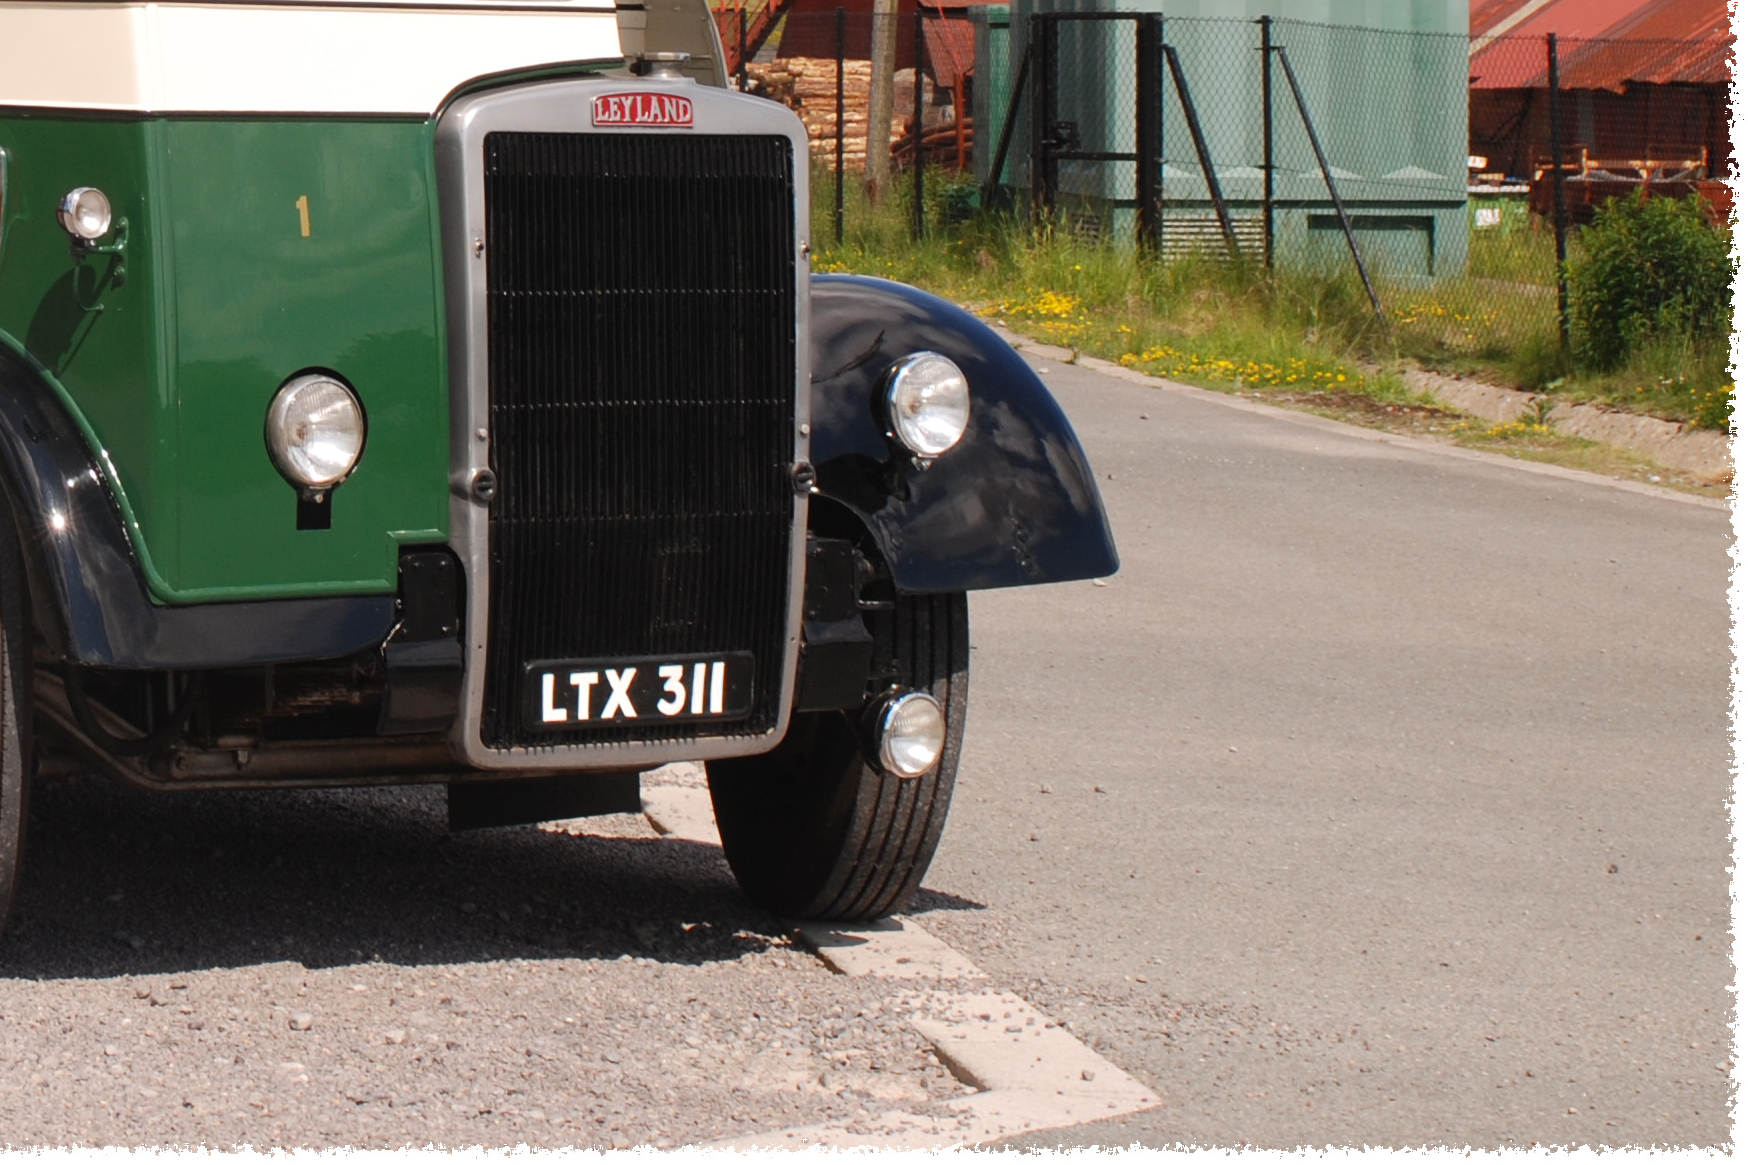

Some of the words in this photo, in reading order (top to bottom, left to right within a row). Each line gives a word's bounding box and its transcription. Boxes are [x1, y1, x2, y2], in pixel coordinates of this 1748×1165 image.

[595, 95, 692, 123] LEYLAND
[295, 195, 310, 237] 1
[542, 667, 638, 722] LTX
[656, 661, 726, 716] 311
